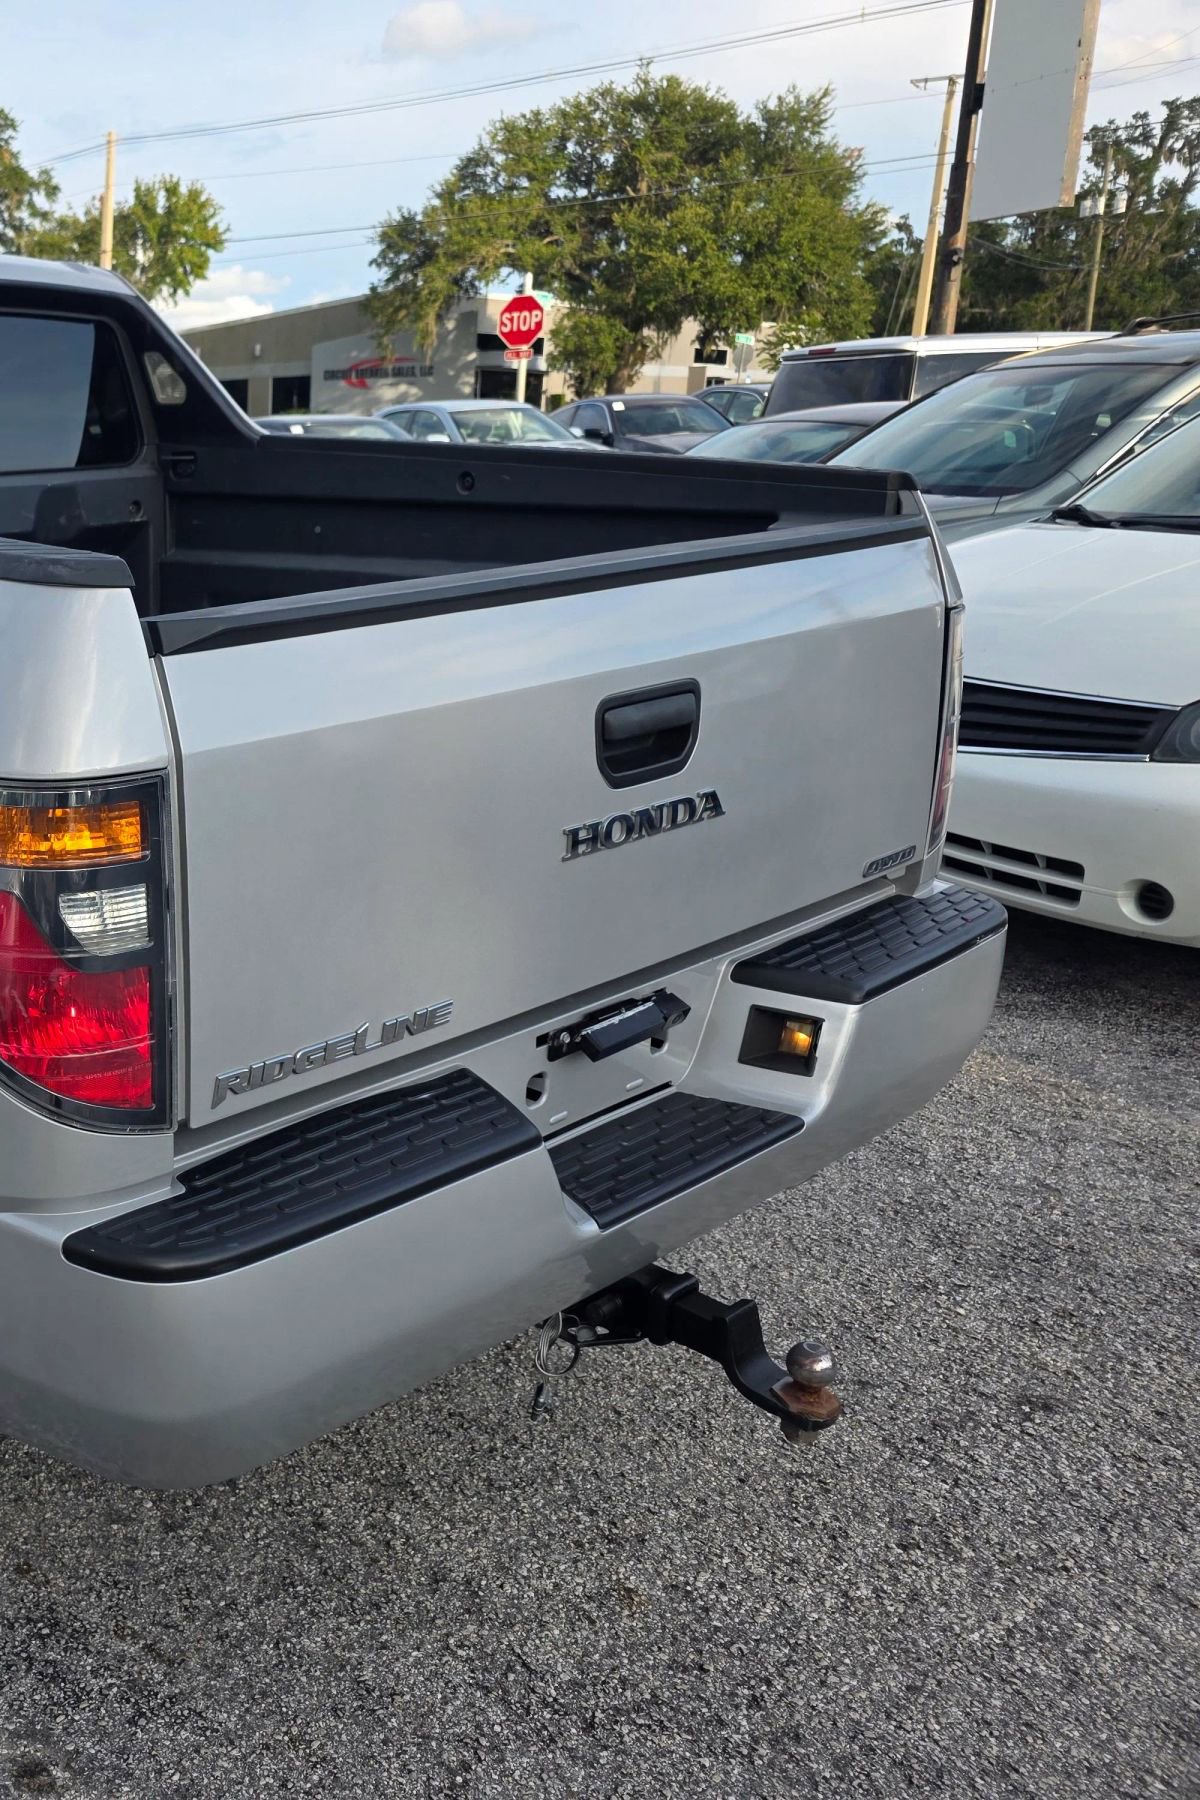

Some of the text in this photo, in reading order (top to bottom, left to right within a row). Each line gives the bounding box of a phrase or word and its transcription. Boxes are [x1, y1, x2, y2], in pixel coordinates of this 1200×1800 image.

[501, 309, 543, 333] STOP
[561, 788, 726, 862] HONDA
[864, 846, 916, 877] 4WD
[211, 999, 454, 1110] RIDGELINE
